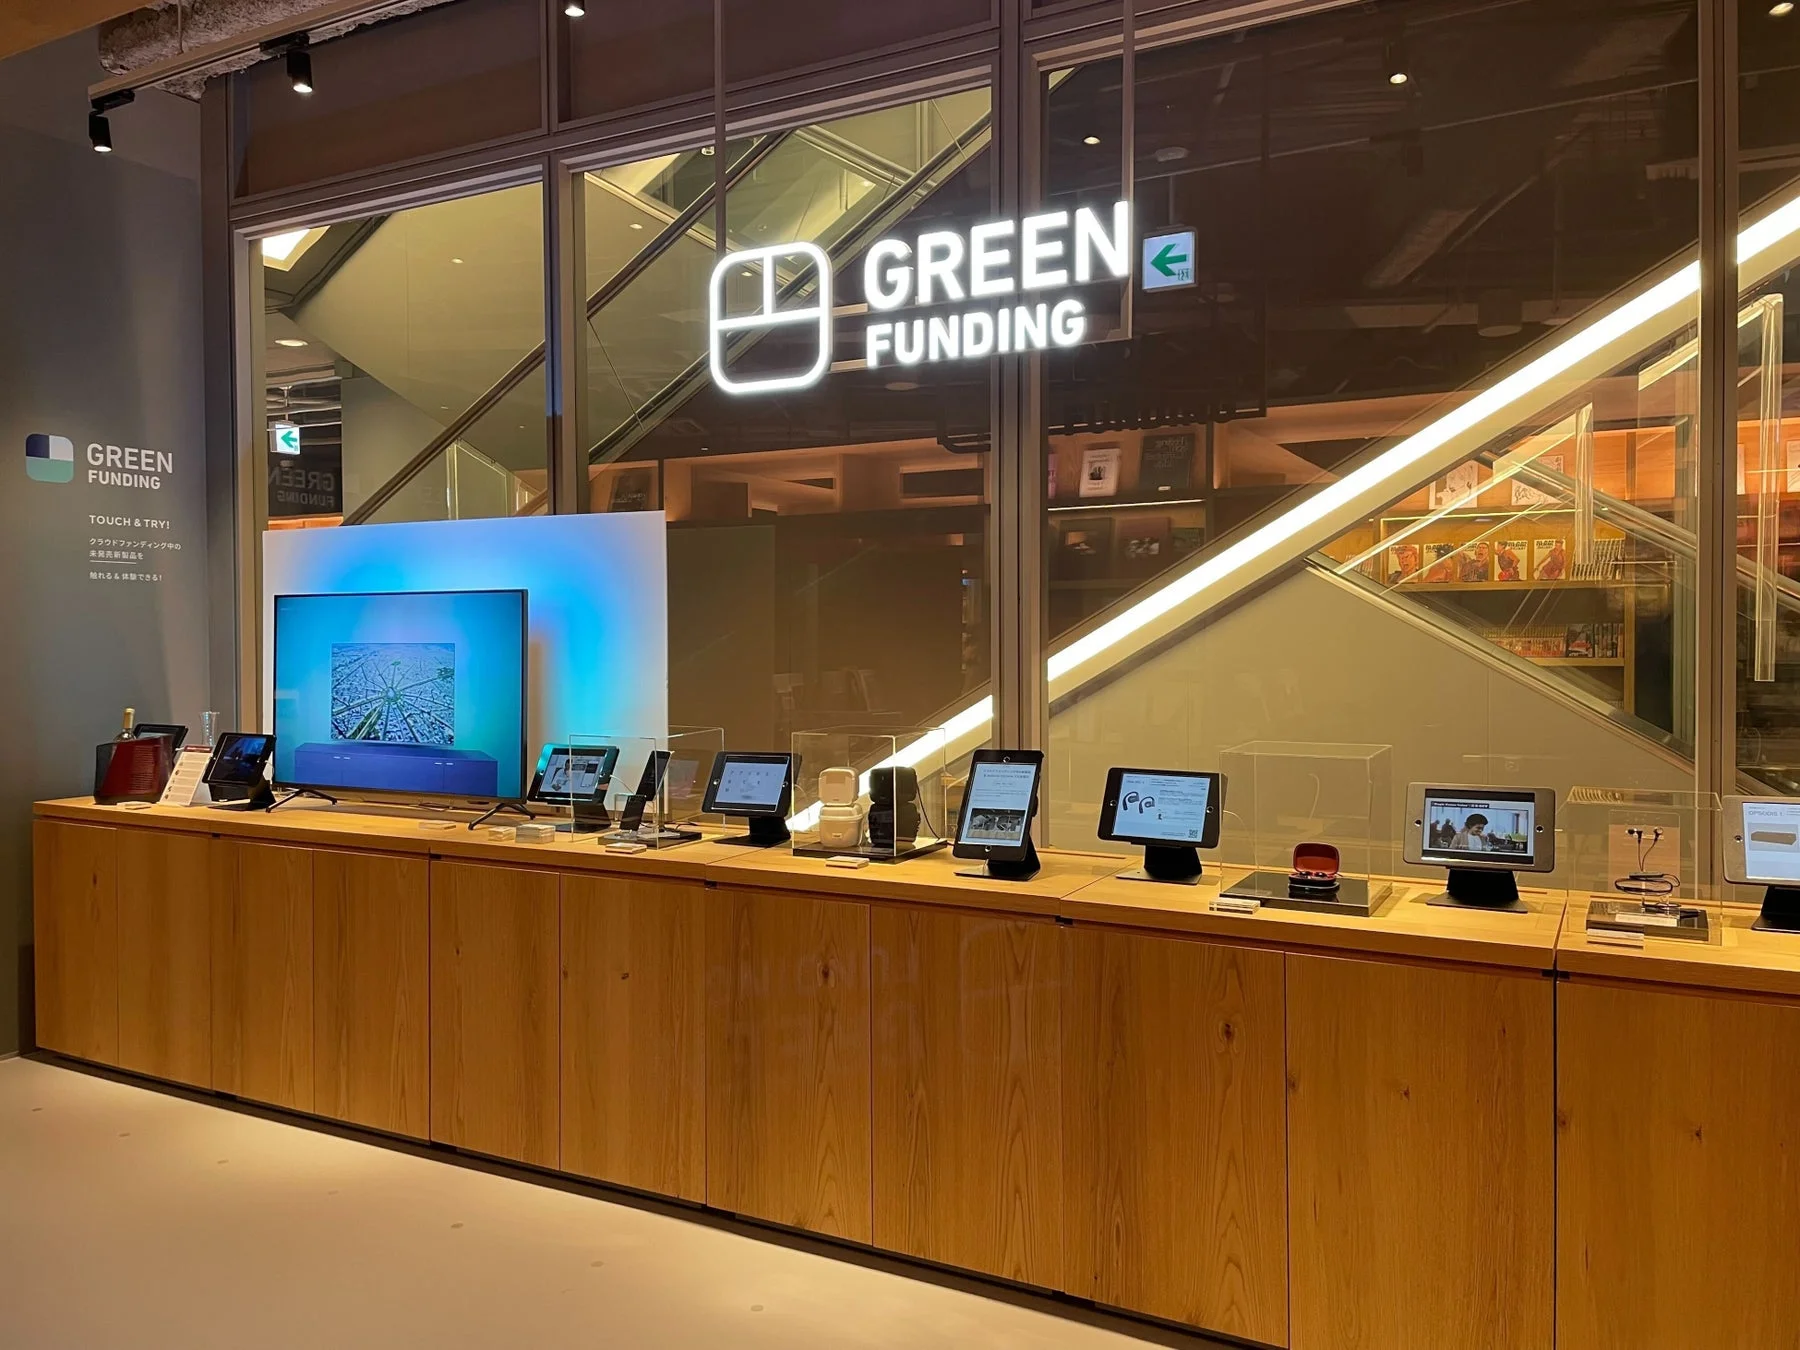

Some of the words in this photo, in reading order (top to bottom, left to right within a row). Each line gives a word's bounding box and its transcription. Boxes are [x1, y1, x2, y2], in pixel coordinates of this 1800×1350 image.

[864, 200, 1130, 310] GREEN
[866, 298, 1086, 369] FUNDING
[86, 443, 173, 474] GREEN
[88, 469, 161, 490] FUNDING
[88, 514, 131, 527] TOUCH
[133, 518, 142, 528] &
[143, 519, 170, 530] TRY!
[89, 537, 182, 551] クラウドファンディング中の
[89, 549, 144, 560] 未発売新製品を
